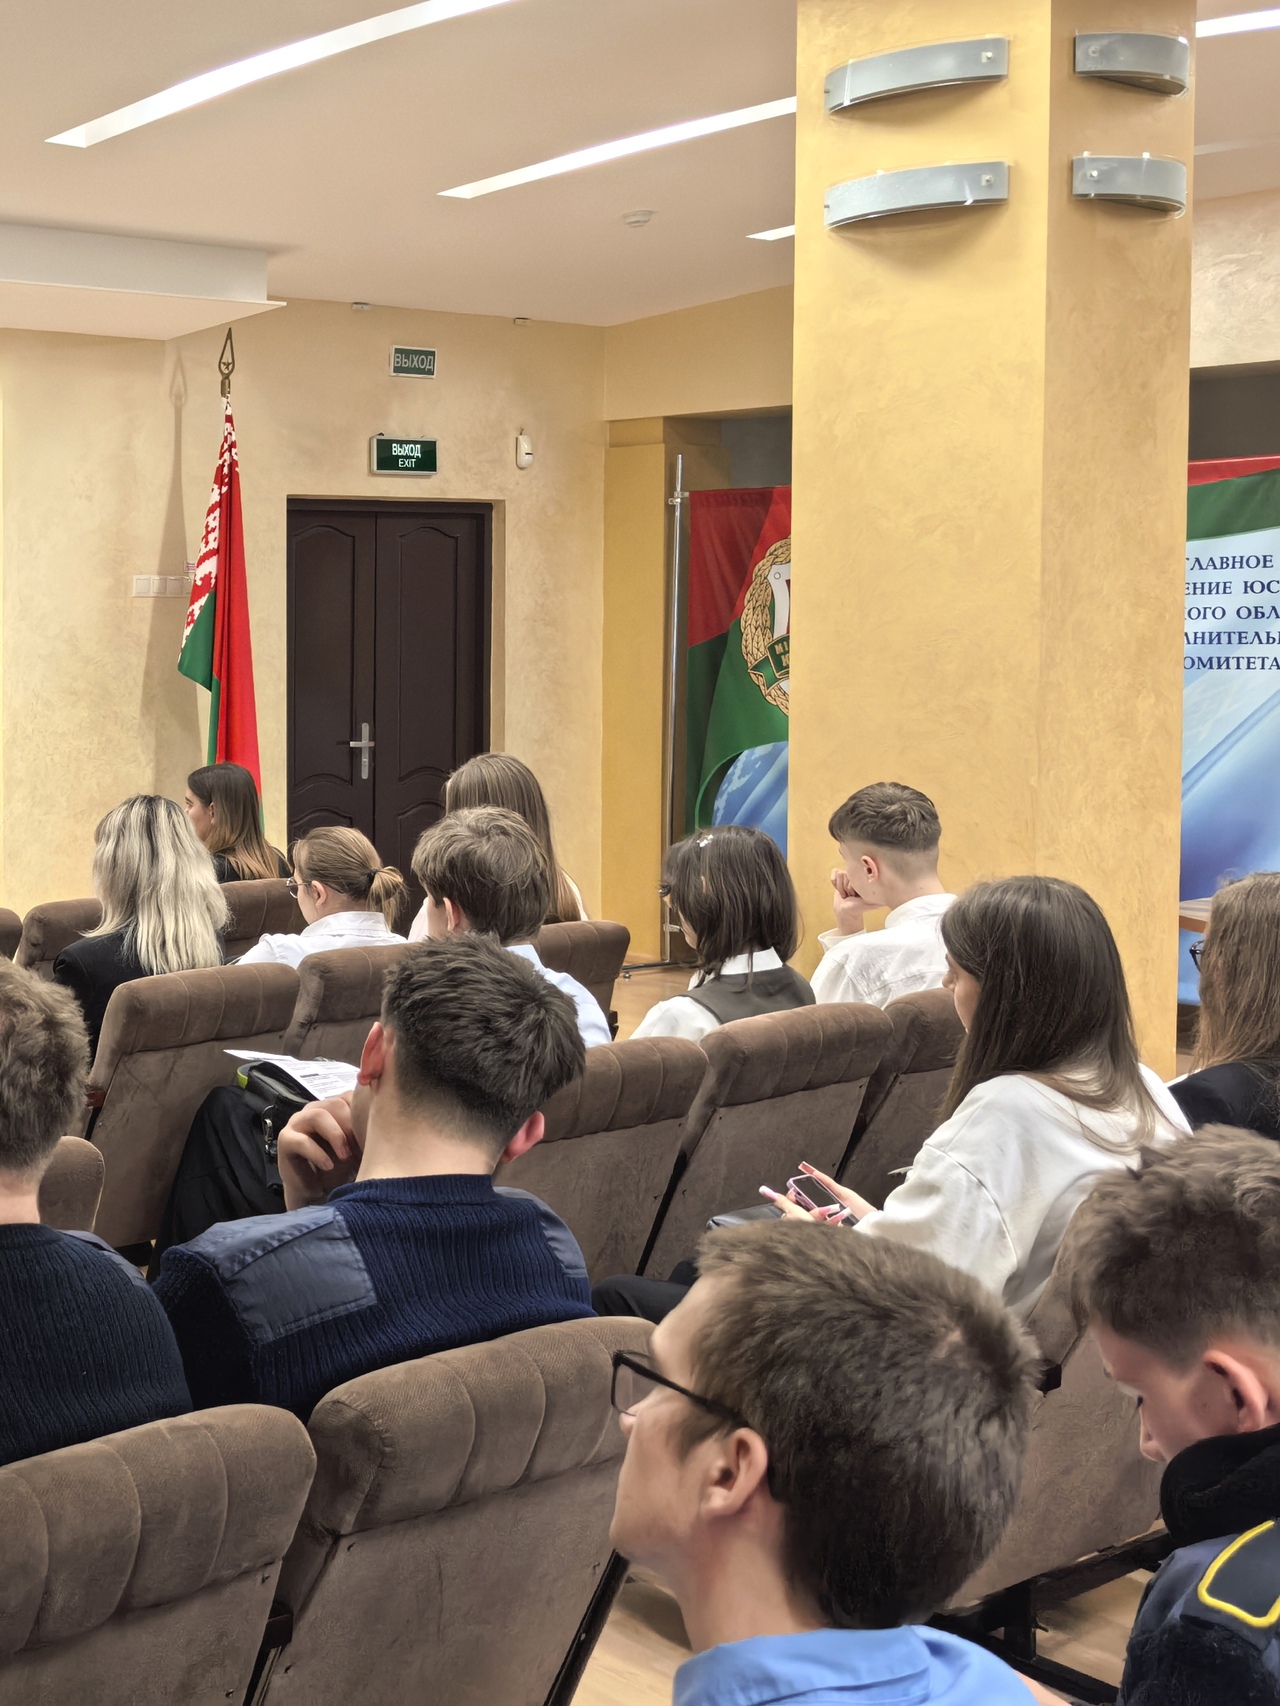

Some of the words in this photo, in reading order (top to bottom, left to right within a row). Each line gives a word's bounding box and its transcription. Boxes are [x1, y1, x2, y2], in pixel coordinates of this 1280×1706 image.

[394, 353, 434, 372] ВЫХОД
[392, 443, 421, 458] ВЫХОД
[398, 459, 416, 468] EXIT
[1185, 554, 1274, 571] ЛАВНОЕ
[1184, 606, 1227, 621] ОГО
[1184, 630, 1280, 645] НИТЕЛЬ
